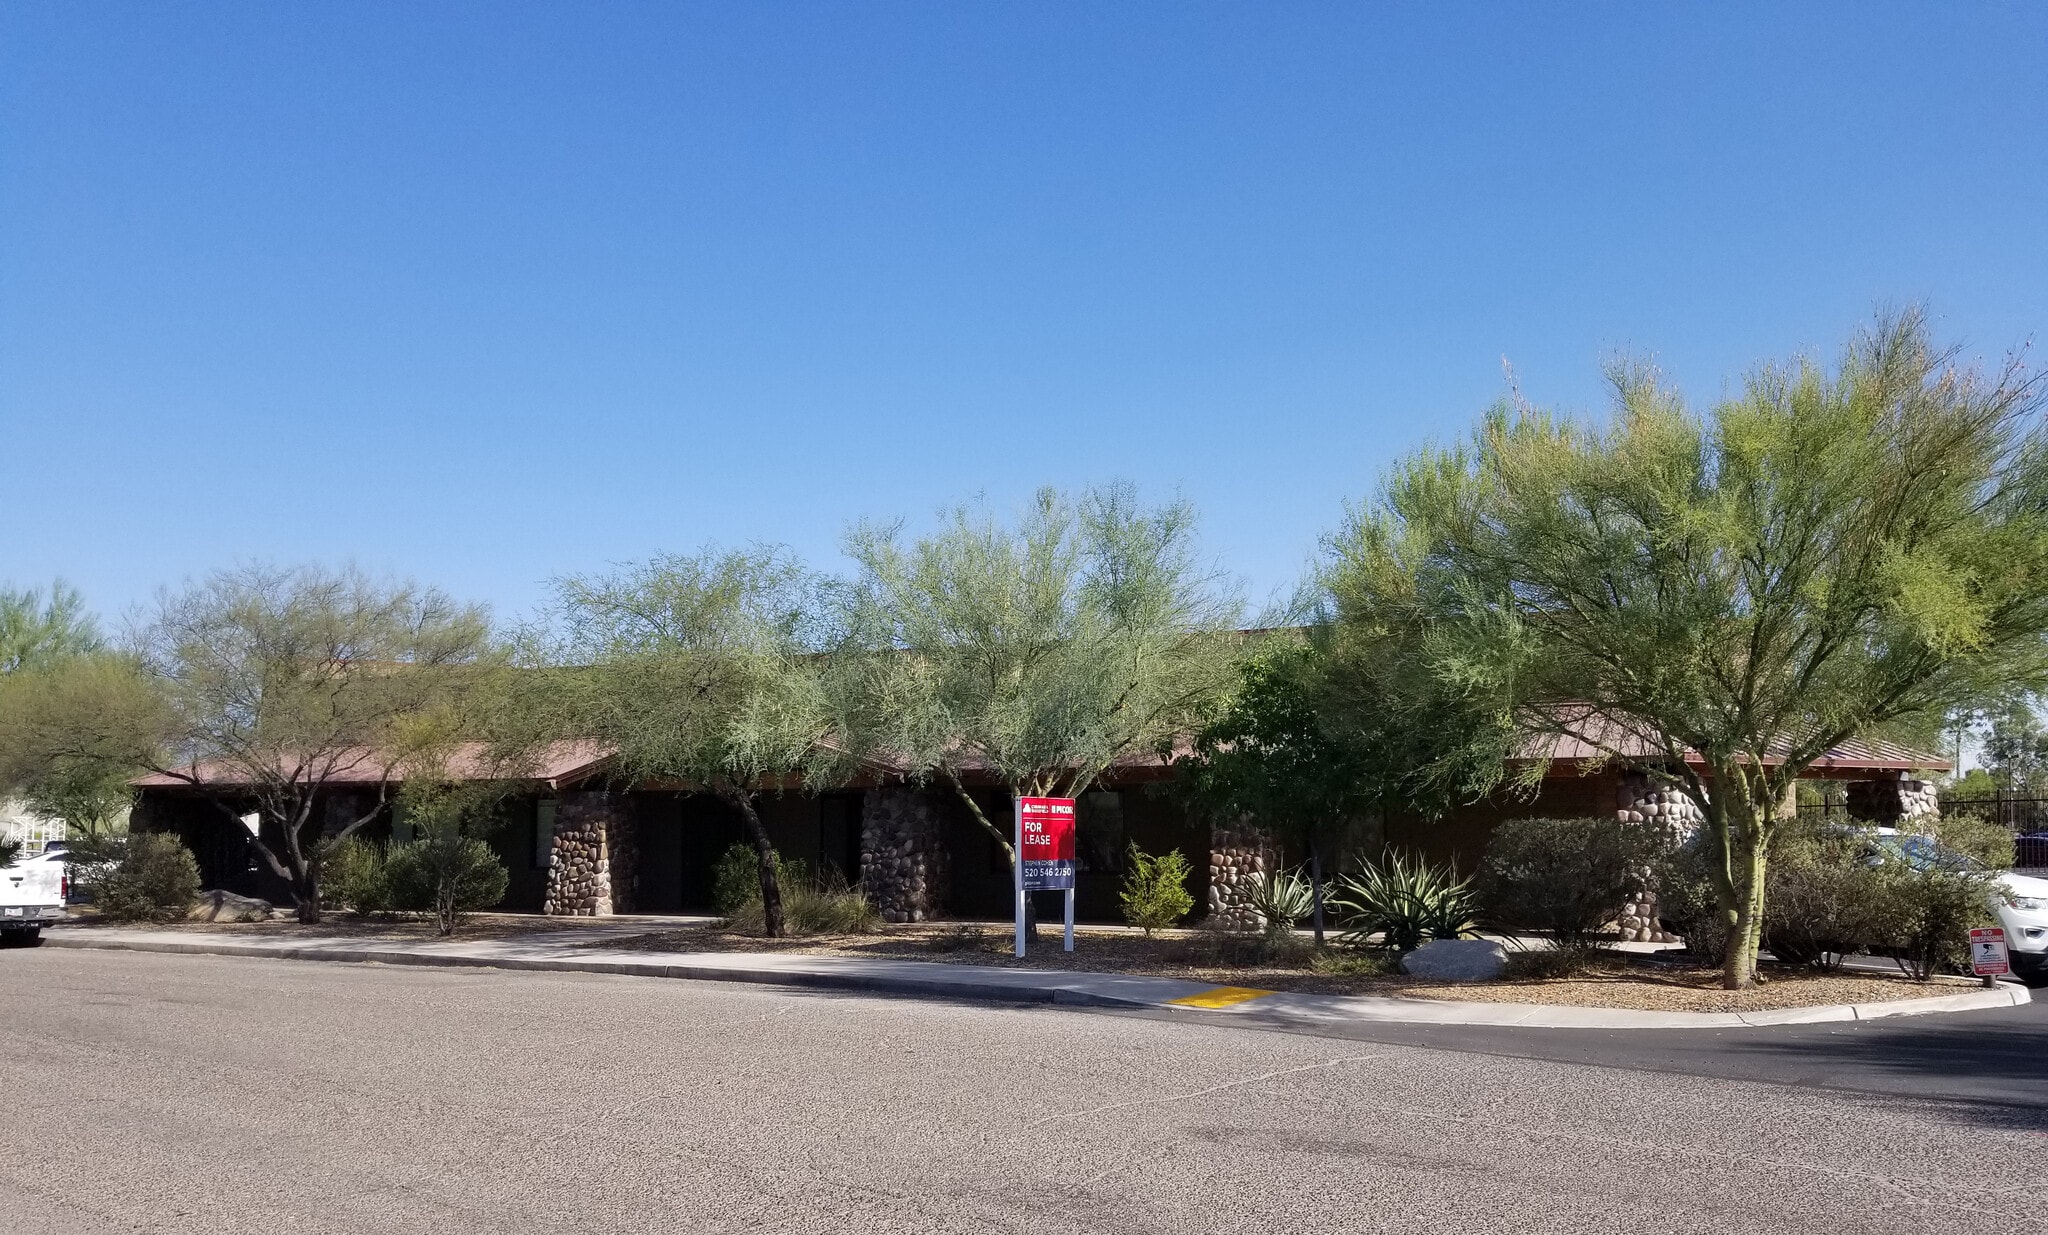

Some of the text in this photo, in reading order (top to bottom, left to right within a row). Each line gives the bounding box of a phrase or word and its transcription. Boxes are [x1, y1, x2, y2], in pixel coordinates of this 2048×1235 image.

[1025, 822, 1042, 832] FOR
[1025, 834, 1050, 845] LEASE
[1025, 867, 1072, 877] 520 546 2750
